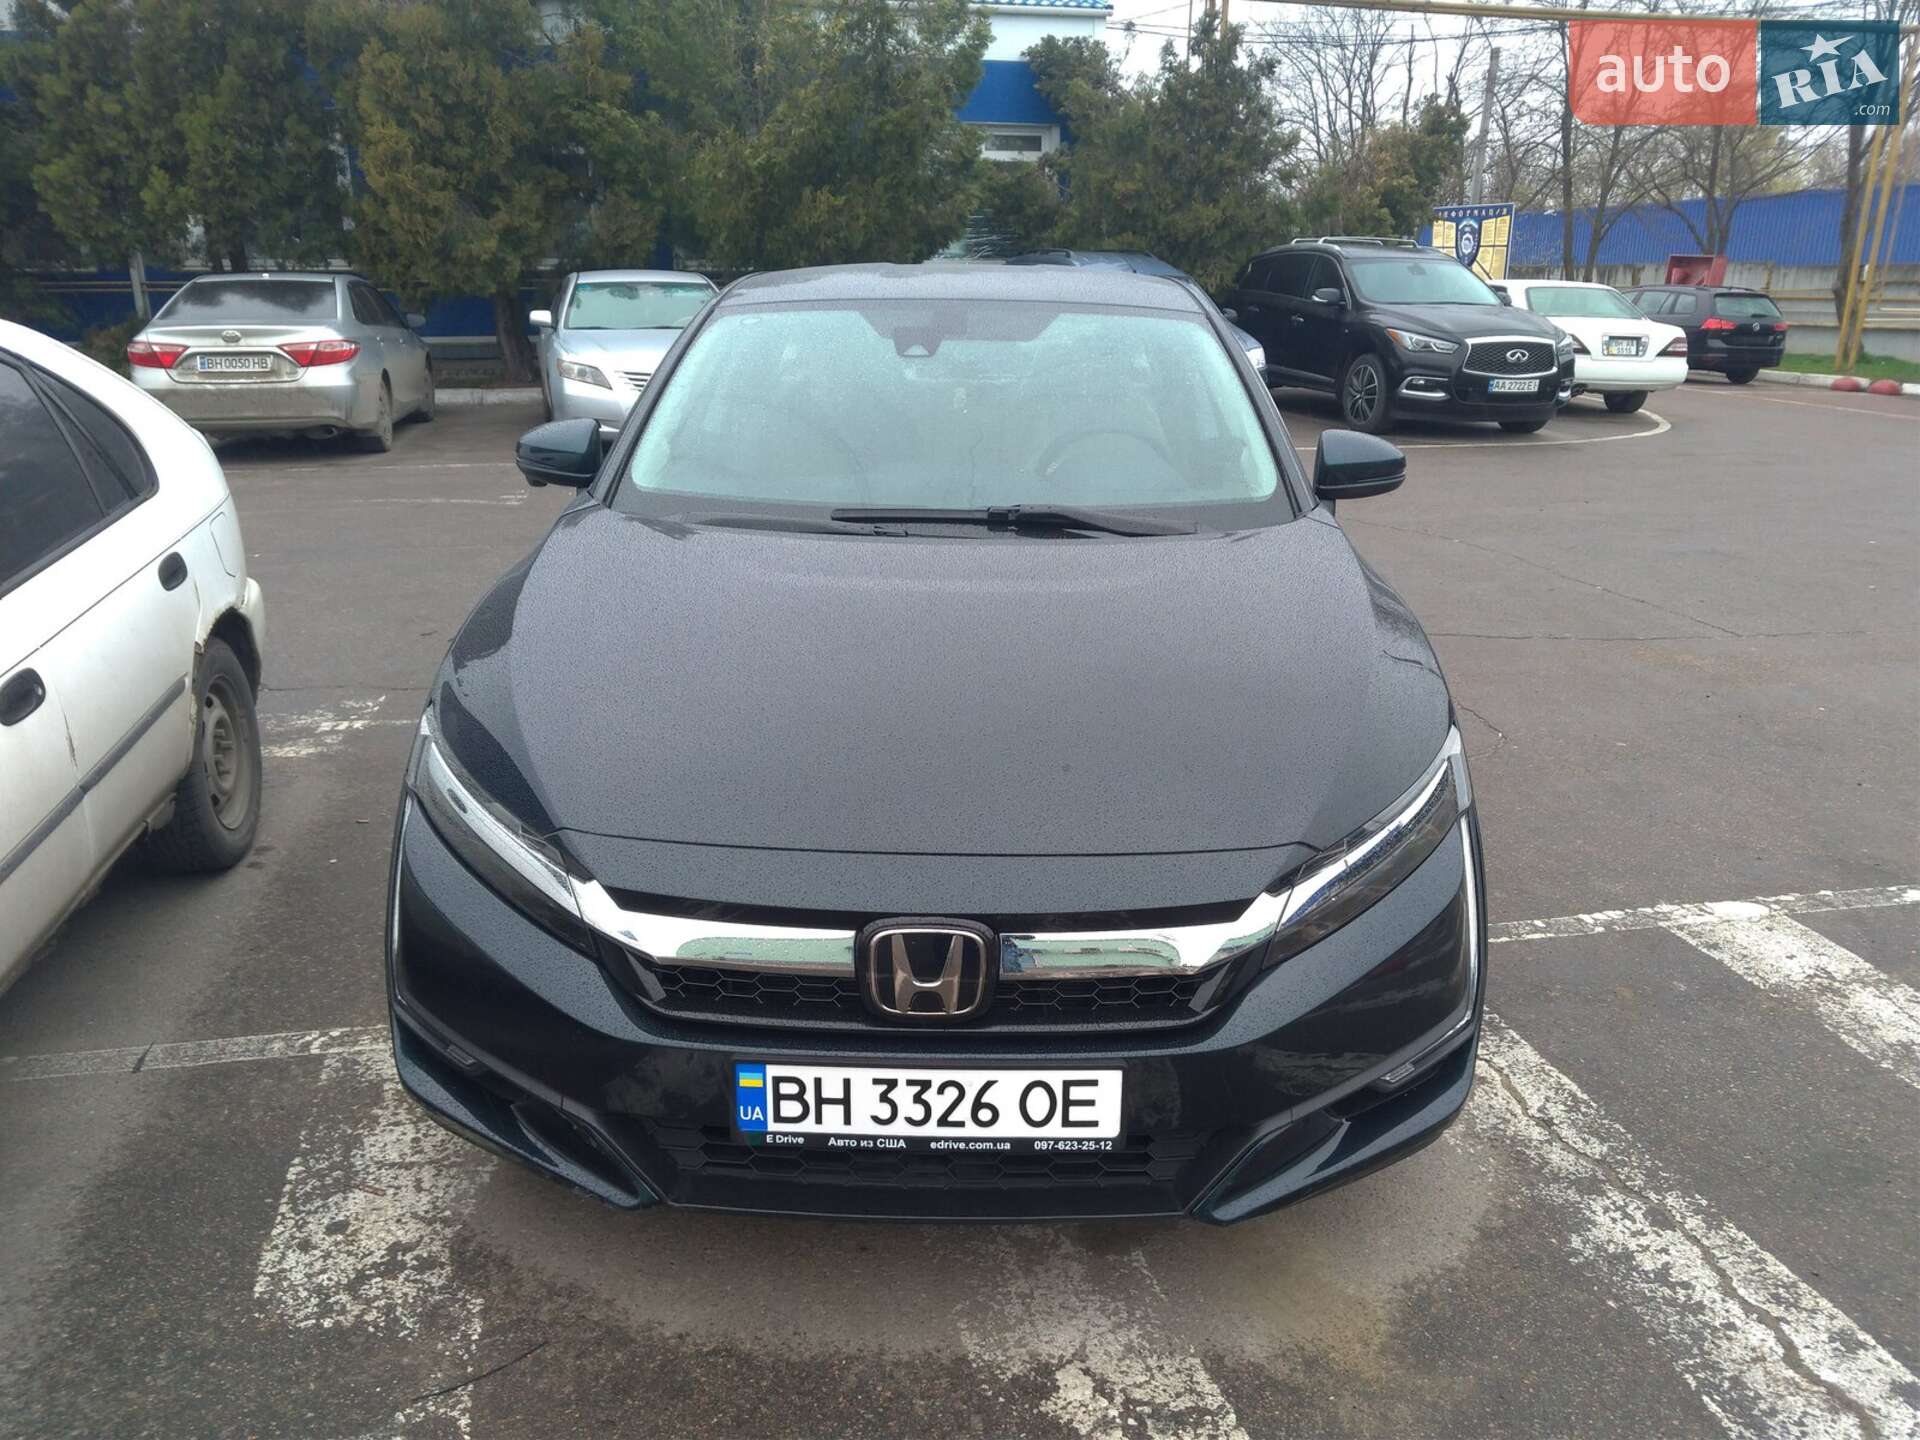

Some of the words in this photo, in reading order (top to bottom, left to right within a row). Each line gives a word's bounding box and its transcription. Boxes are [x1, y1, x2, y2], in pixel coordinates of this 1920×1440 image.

[207, 358, 223, 369] BH
[224, 358, 251, 369] 0050
[252, 358, 269, 369] HB
[772, 1076, 851, 1126] BH
[870, 1078, 1000, 1128] 3326
[1019, 1079, 1099, 1128] OE
[740, 1105, 764, 1121] UA
[776, 1134, 805, 1144] Drive
[828, 1137, 857, 1148] Авто
[860, 1140, 873, 1148] из
[877, 1138, 907, 1148] США
[929, 1140, 1011, 1150] edrive.com.ua
[1034, 1140, 1113, 1151] 097-623-25-12
